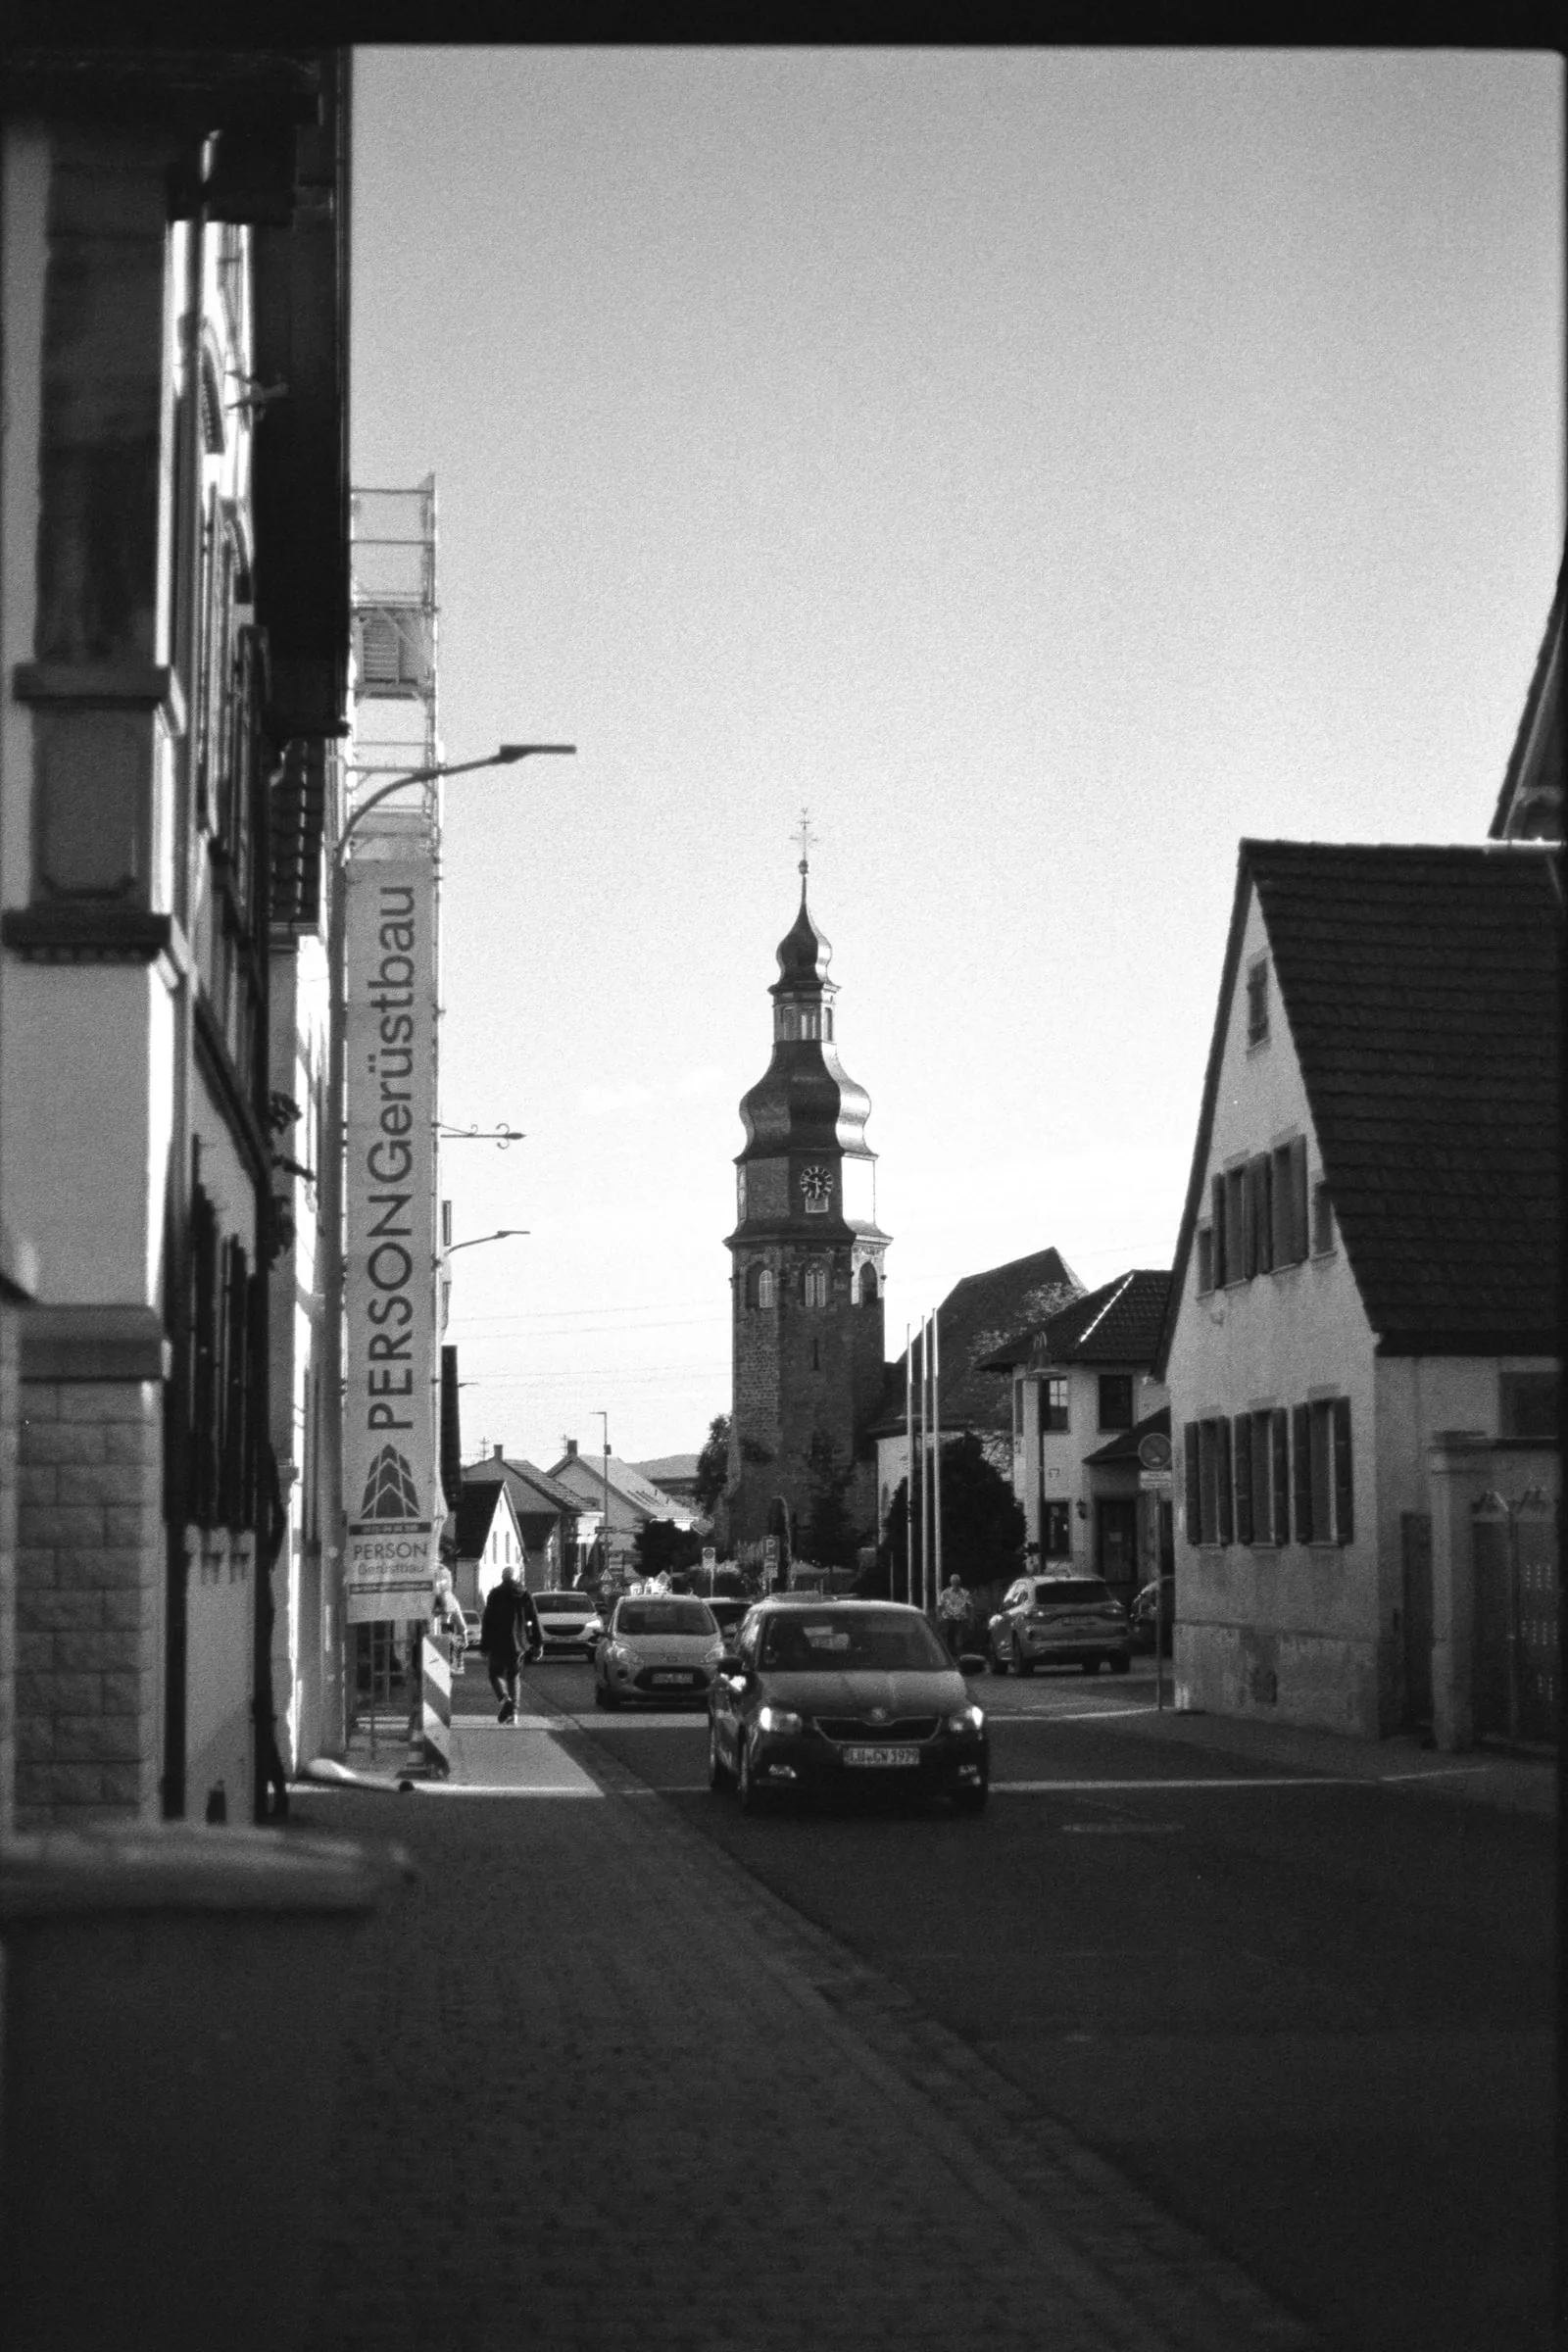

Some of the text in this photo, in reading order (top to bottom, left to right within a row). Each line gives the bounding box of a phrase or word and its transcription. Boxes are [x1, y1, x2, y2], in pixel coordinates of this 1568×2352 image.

[367, 887, 416, 1431] PERSON Gerüstbau
[354, 1542, 428, 1560] PERSON
[765, 1539, 775, 1553] P
